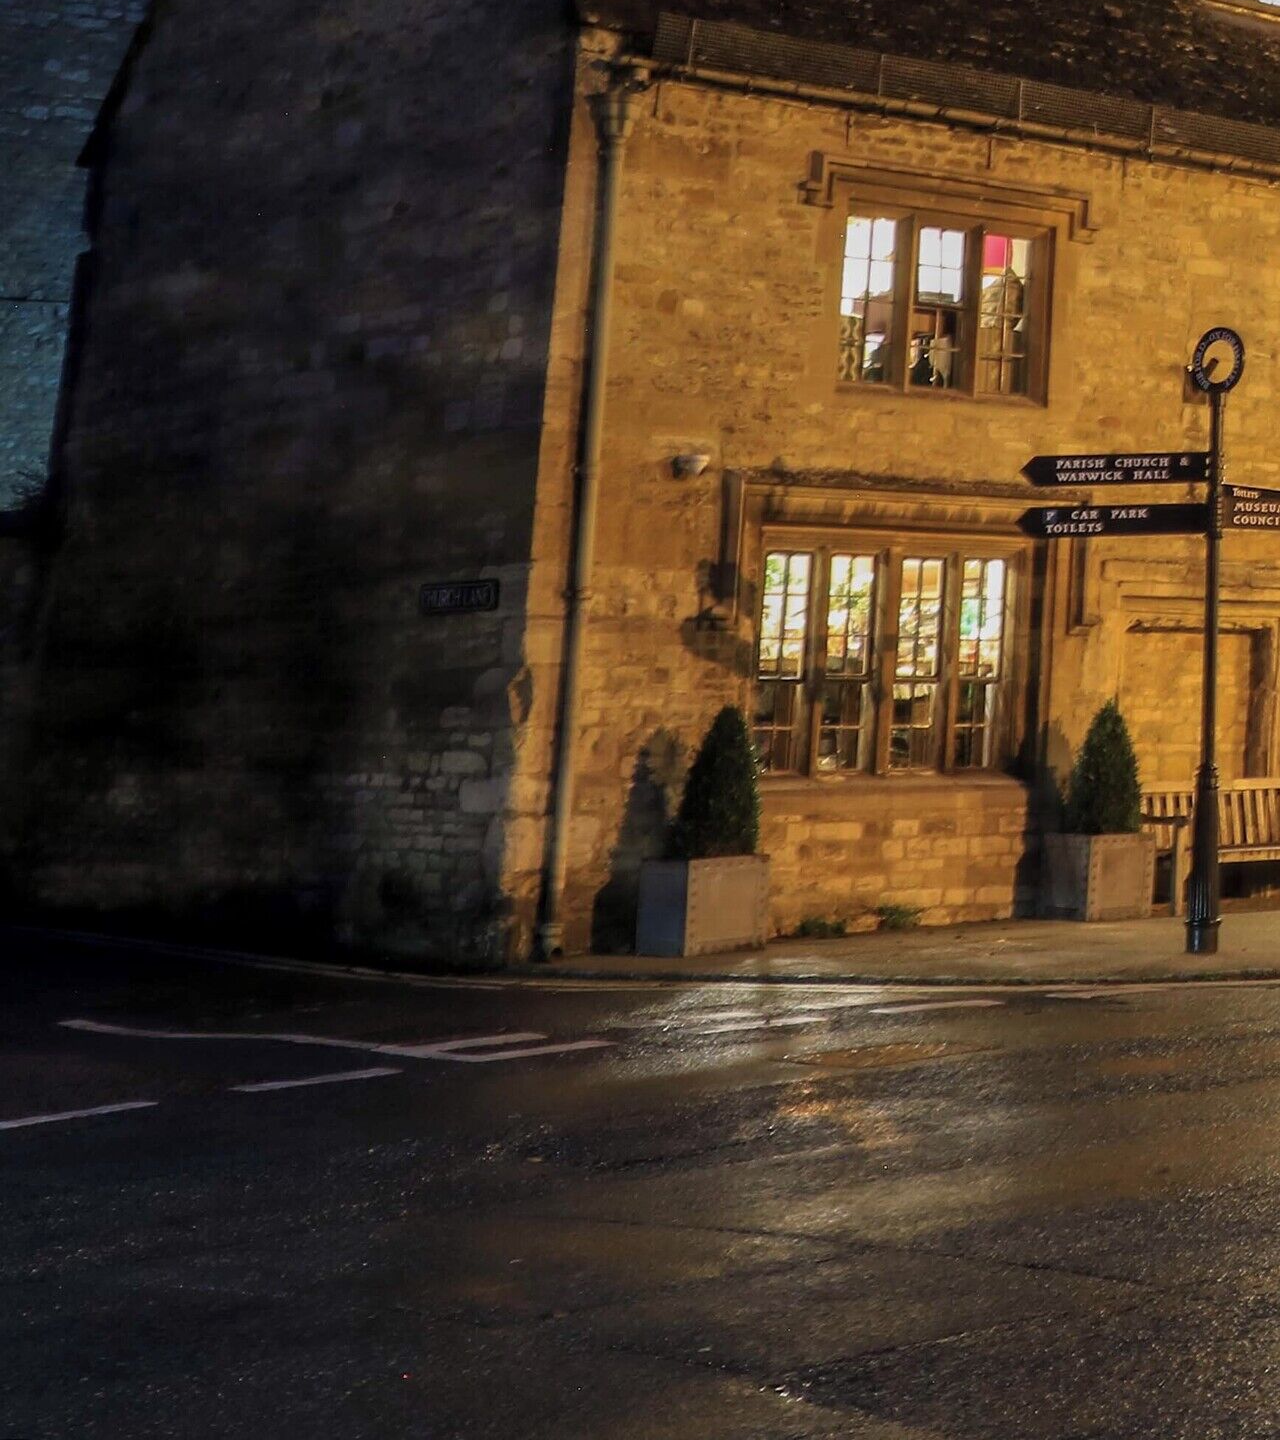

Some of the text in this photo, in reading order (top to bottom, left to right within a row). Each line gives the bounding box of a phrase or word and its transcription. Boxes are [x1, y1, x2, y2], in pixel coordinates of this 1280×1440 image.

[1056, 457, 1189, 469] PARISH CHURCH &
[1056, 470, 1170, 482] WARWICK HALL
[1071, 510, 1099, 520] CAR
[1111, 508, 1148, 519] PARK
[1046, 523, 1103, 534] TOILETS
